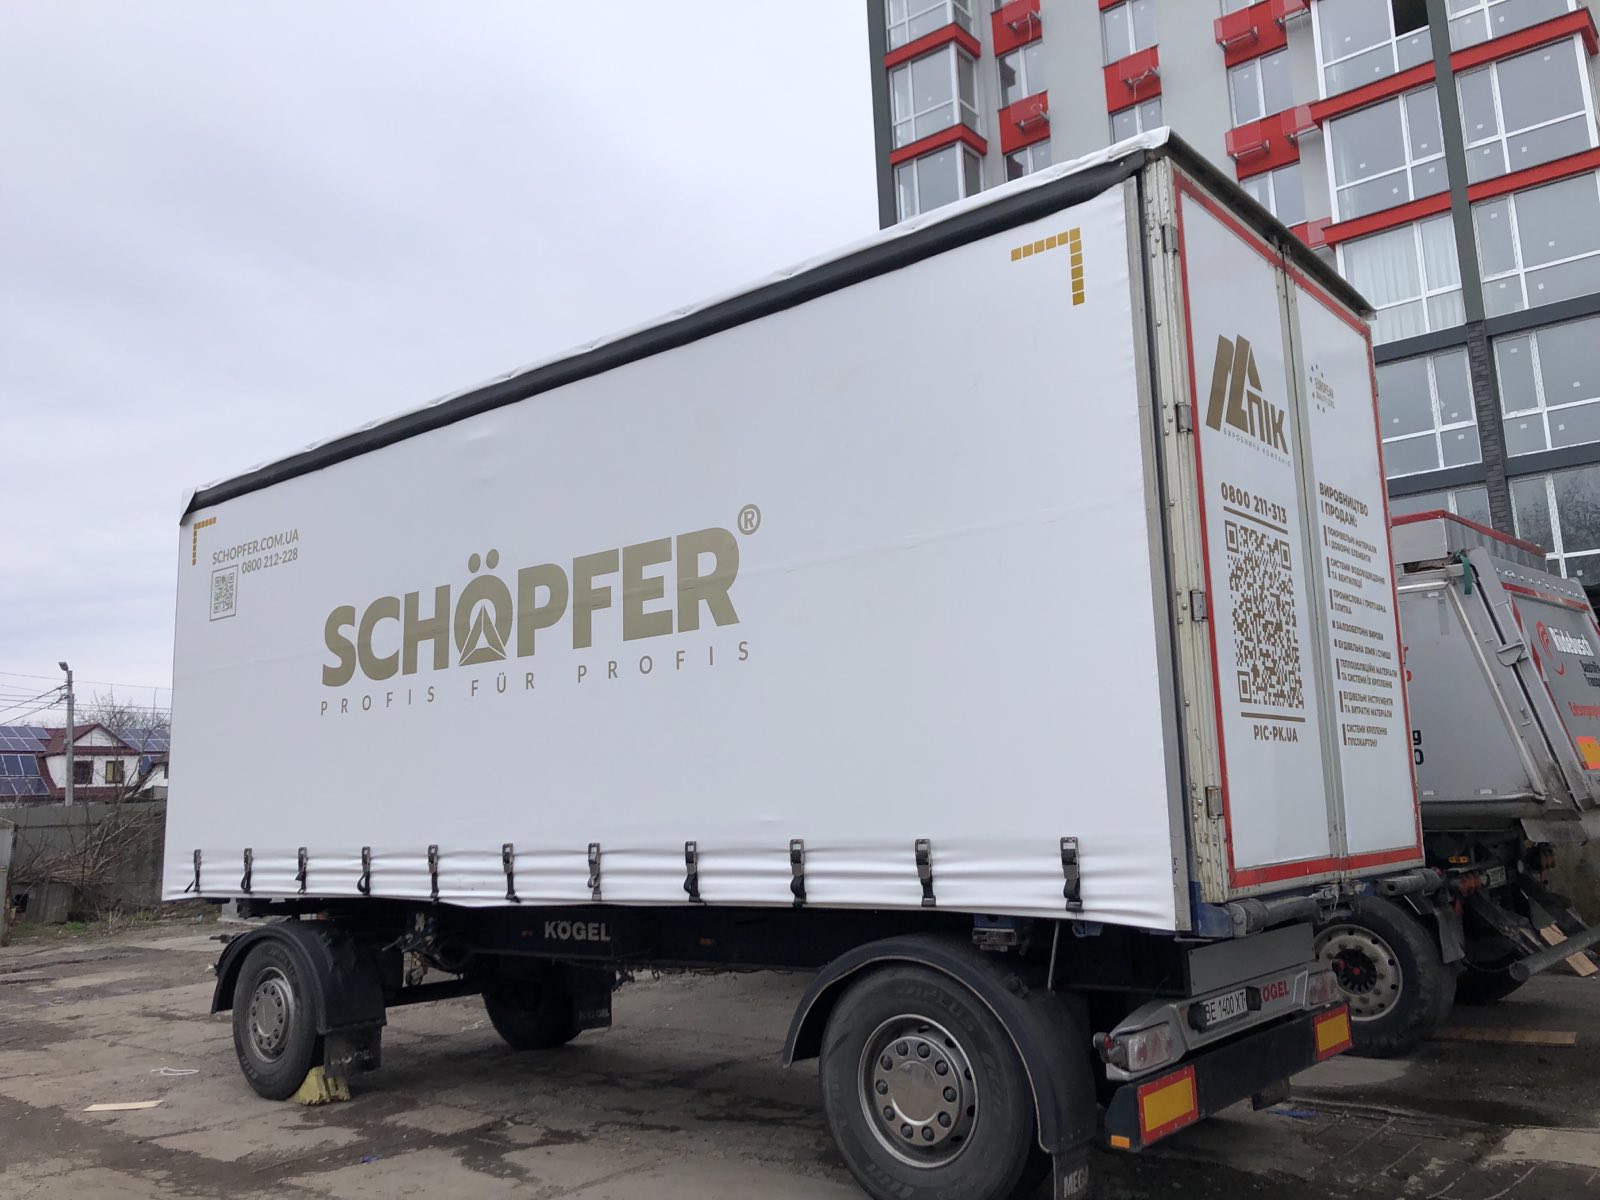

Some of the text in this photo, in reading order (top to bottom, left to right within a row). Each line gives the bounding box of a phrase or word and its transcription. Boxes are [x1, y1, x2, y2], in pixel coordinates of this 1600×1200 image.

[1221, 482, 1287, 524] 0800 211-313
[1319, 482, 1369, 517] ВИРОБНИЦТВО
[212, 528, 299, 565] SCHOPFER.COM.UA
[241, 548, 298, 574] 0800 212-228
[320, 641, 749, 716] PROFIS FÜR PROFIS
[1253, 725, 1298, 742] PIC-PK.UA
[545, 920, 611, 941] KÖGEL
[1260, 980, 1290, 1002] ÖGEL
[1205, 1001, 1217, 1022] BE
[1219, 995, 1234, 1017] 1400
